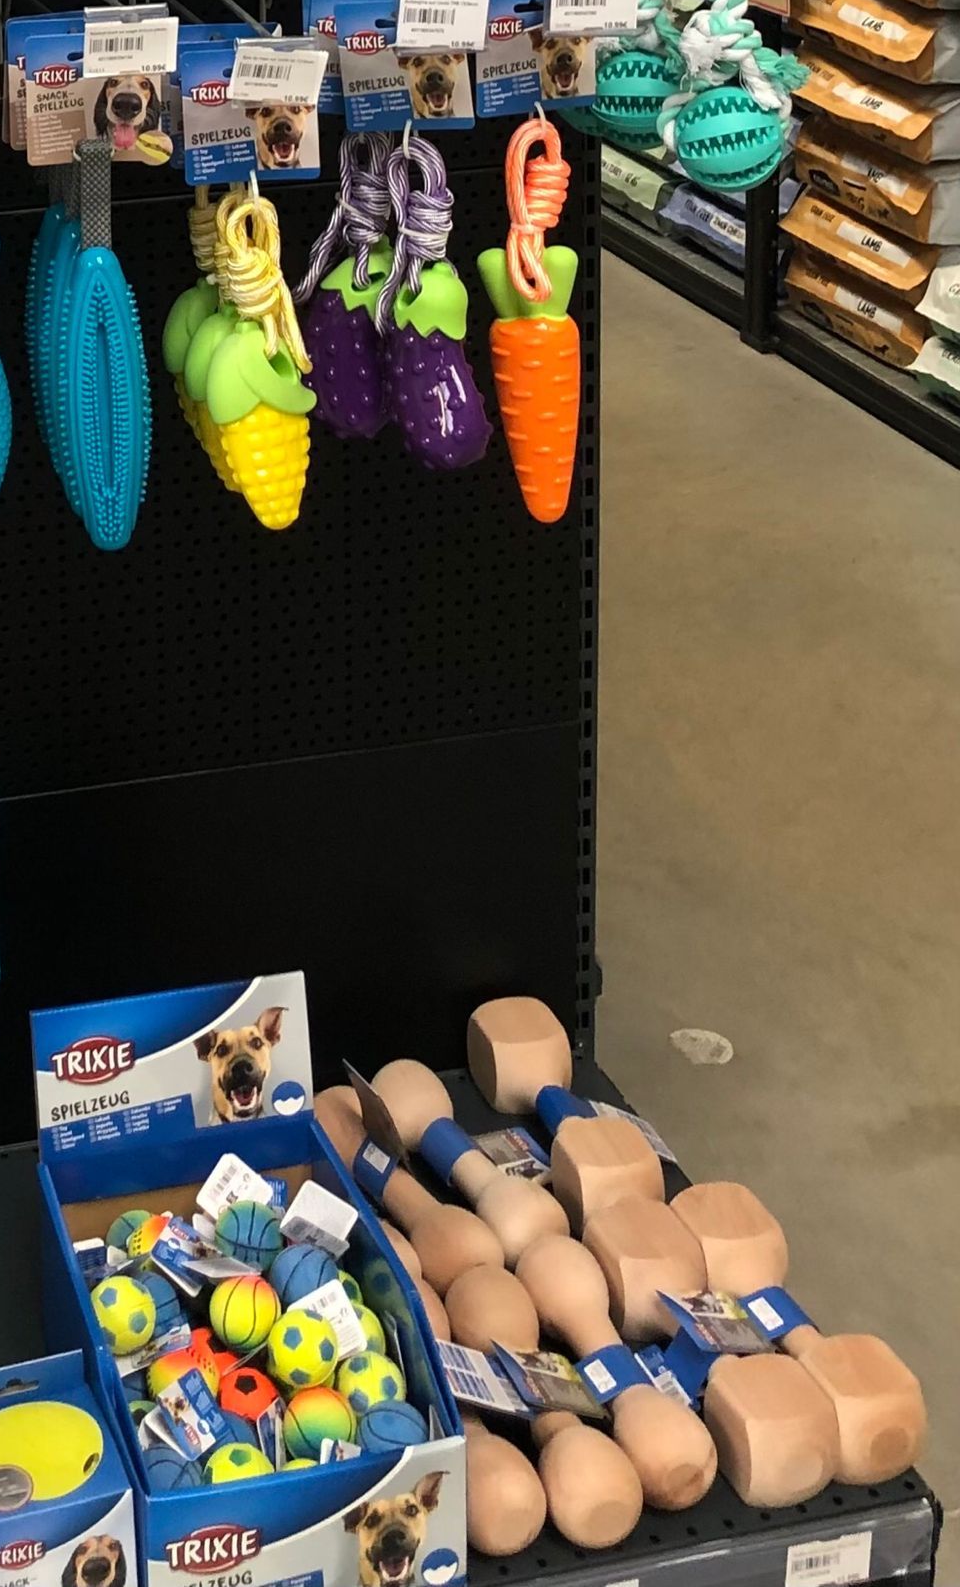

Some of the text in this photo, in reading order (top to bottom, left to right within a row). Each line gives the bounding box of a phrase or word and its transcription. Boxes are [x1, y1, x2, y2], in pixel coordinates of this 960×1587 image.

[345, 34, 386, 52] TRIXIE
[34, 67, 76, 84] TRIXIE
[141, 64, 166, 72] 10.99€
[482, 61, 537, 80] SPIELZEUG
[349, 76, 405, 93] SPIELZEUG
[33, 98, 84, 114] SPIELZEUG
[284, 94, 309, 104] 10.99€
[191, 126, 251, 145] SPIELZEUG
[861, 235, 883, 252] LAMB
[856, 300, 878, 320] LAMB
[51, 1041, 131, 1079] TRIXIE
[51, 1090, 131, 1122] SPIELZEUG
[166, 1527, 258, 1566] TRIXIE
